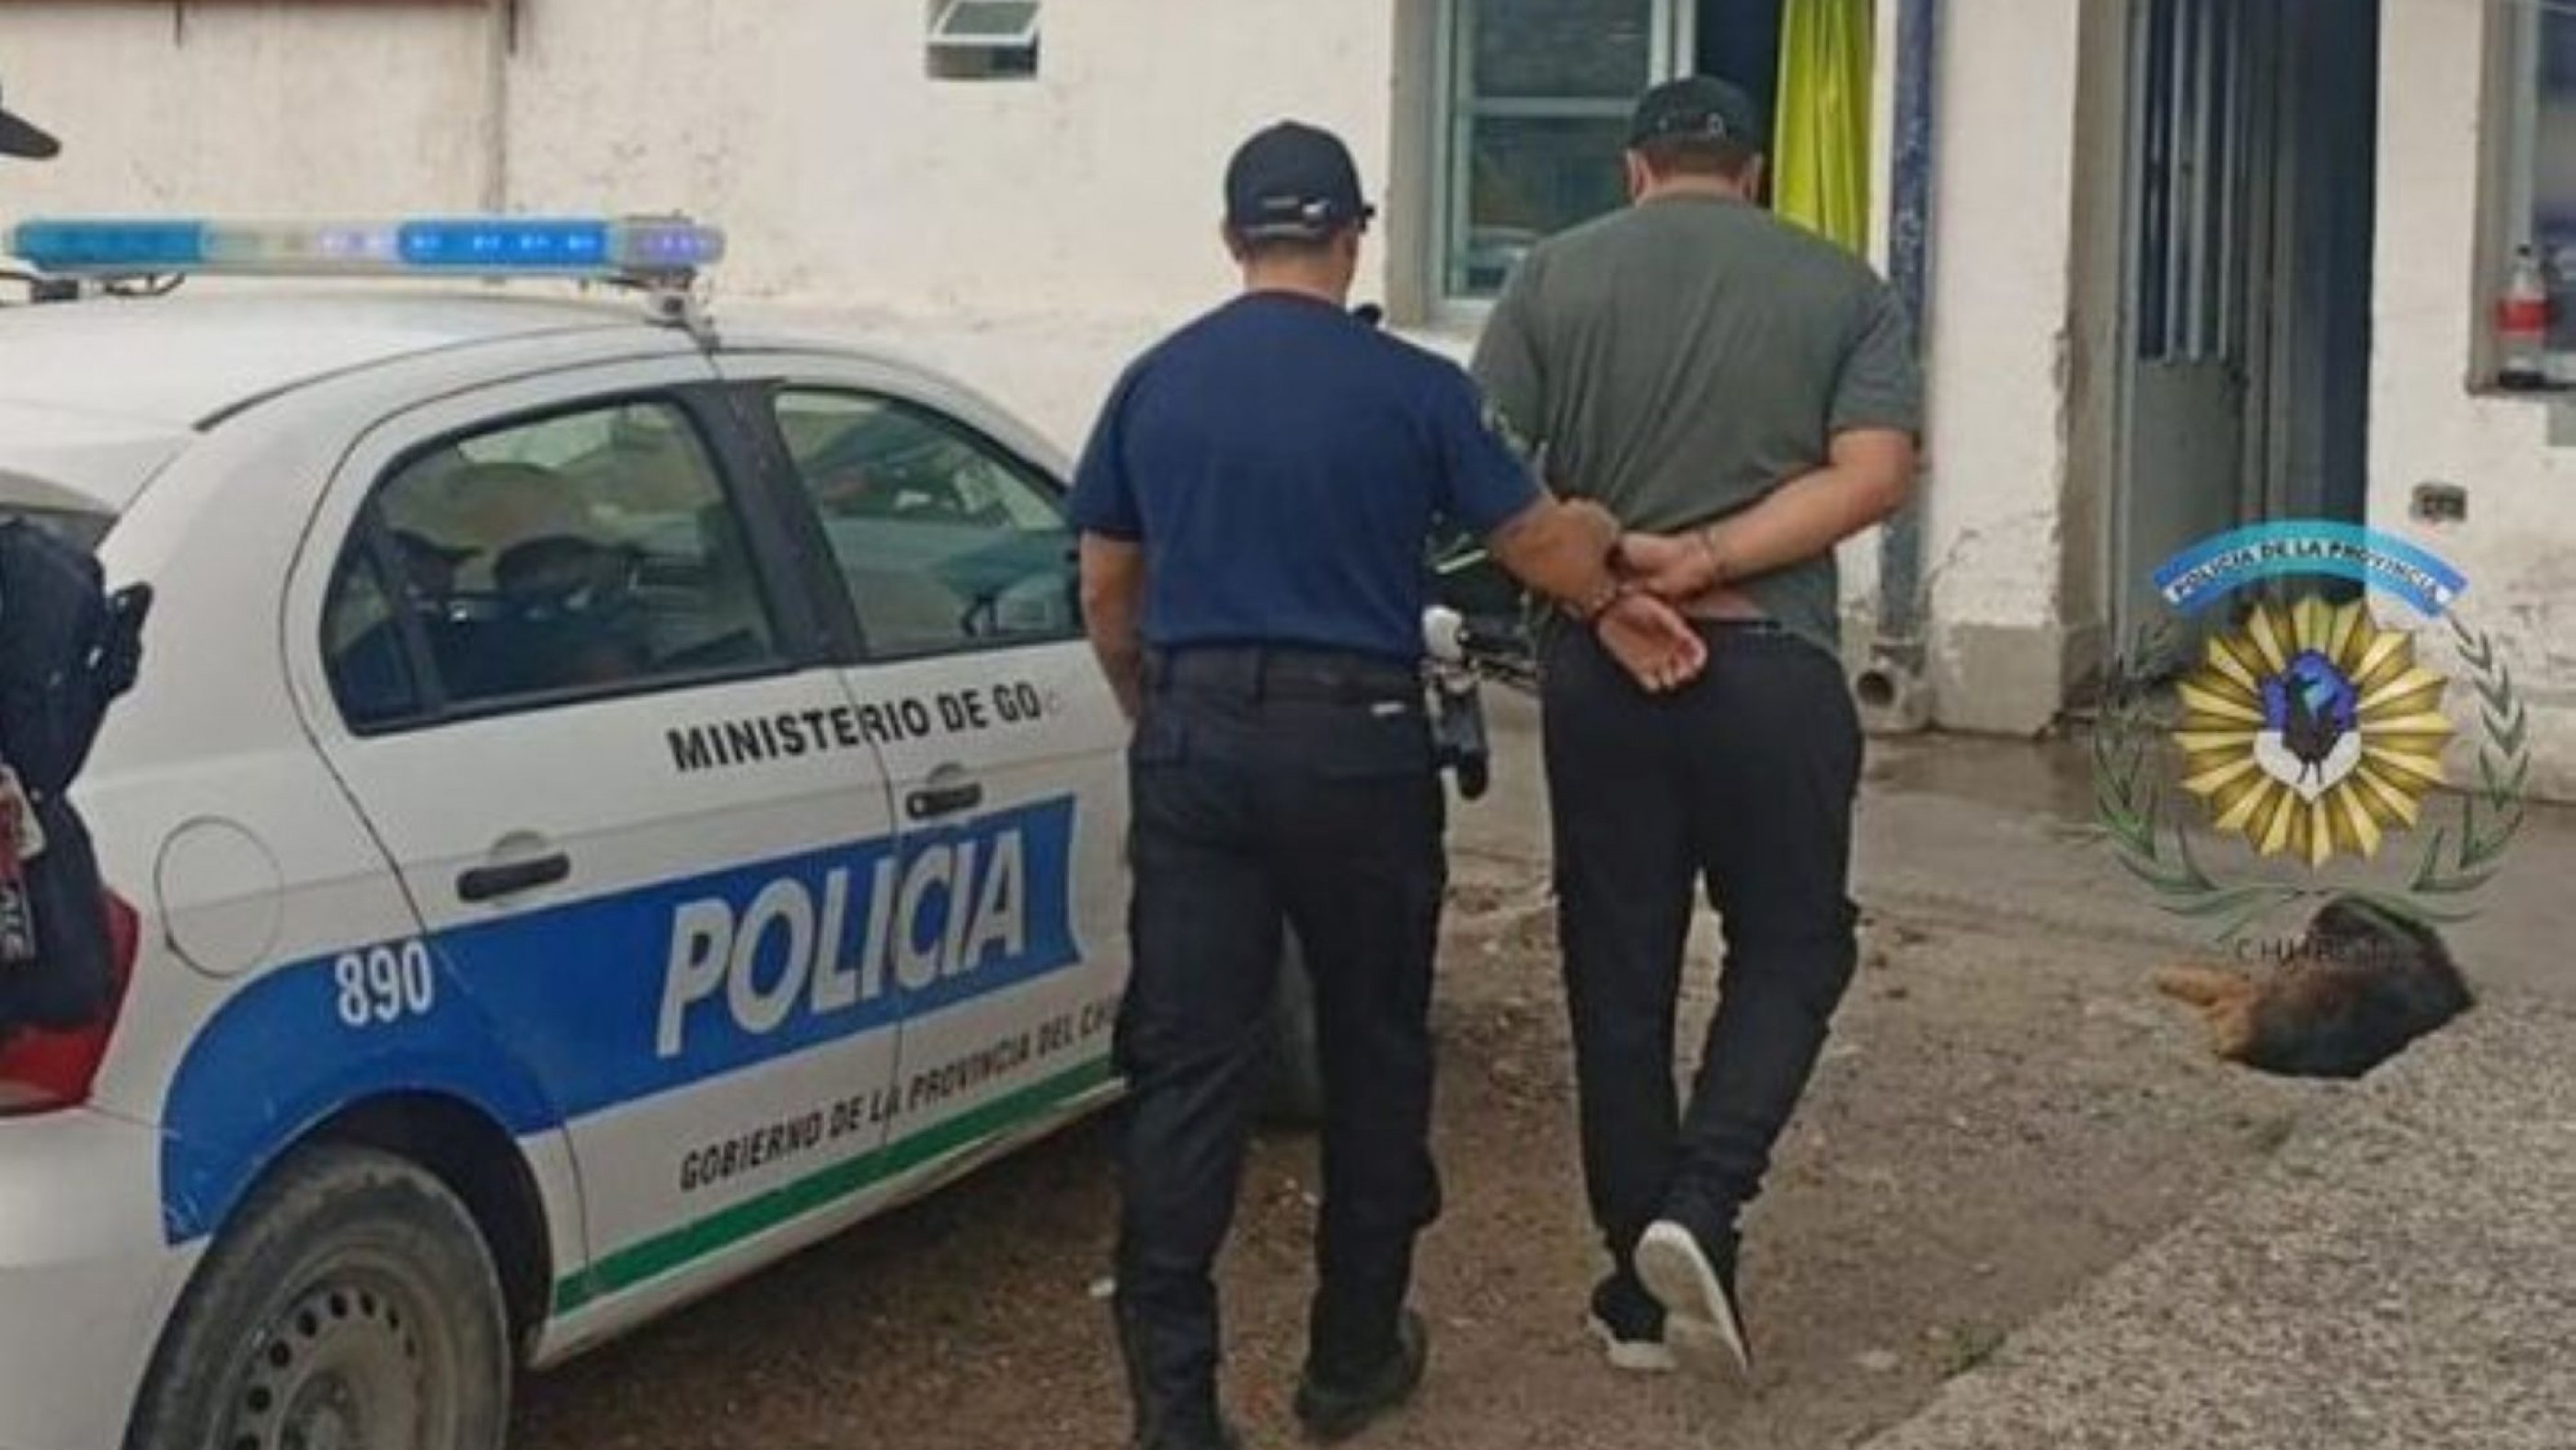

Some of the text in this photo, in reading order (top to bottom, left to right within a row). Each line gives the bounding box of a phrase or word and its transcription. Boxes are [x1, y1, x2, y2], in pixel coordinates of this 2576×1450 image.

[666, 697, 931, 771] MINISTERIO
[935, 688, 989, 733] DE
[333, 939, 434, 1027] 890
[656, 829, 1024, 1059] POLICIA
[680, 1111, 826, 1193] GOBIERNO
[829, 1095, 864, 1138] DE
[868, 1082, 903, 1123] LA
[908, 1031, 1031, 1112] PROVINCIA
[1036, 1013, 1075, 1057] DEL
